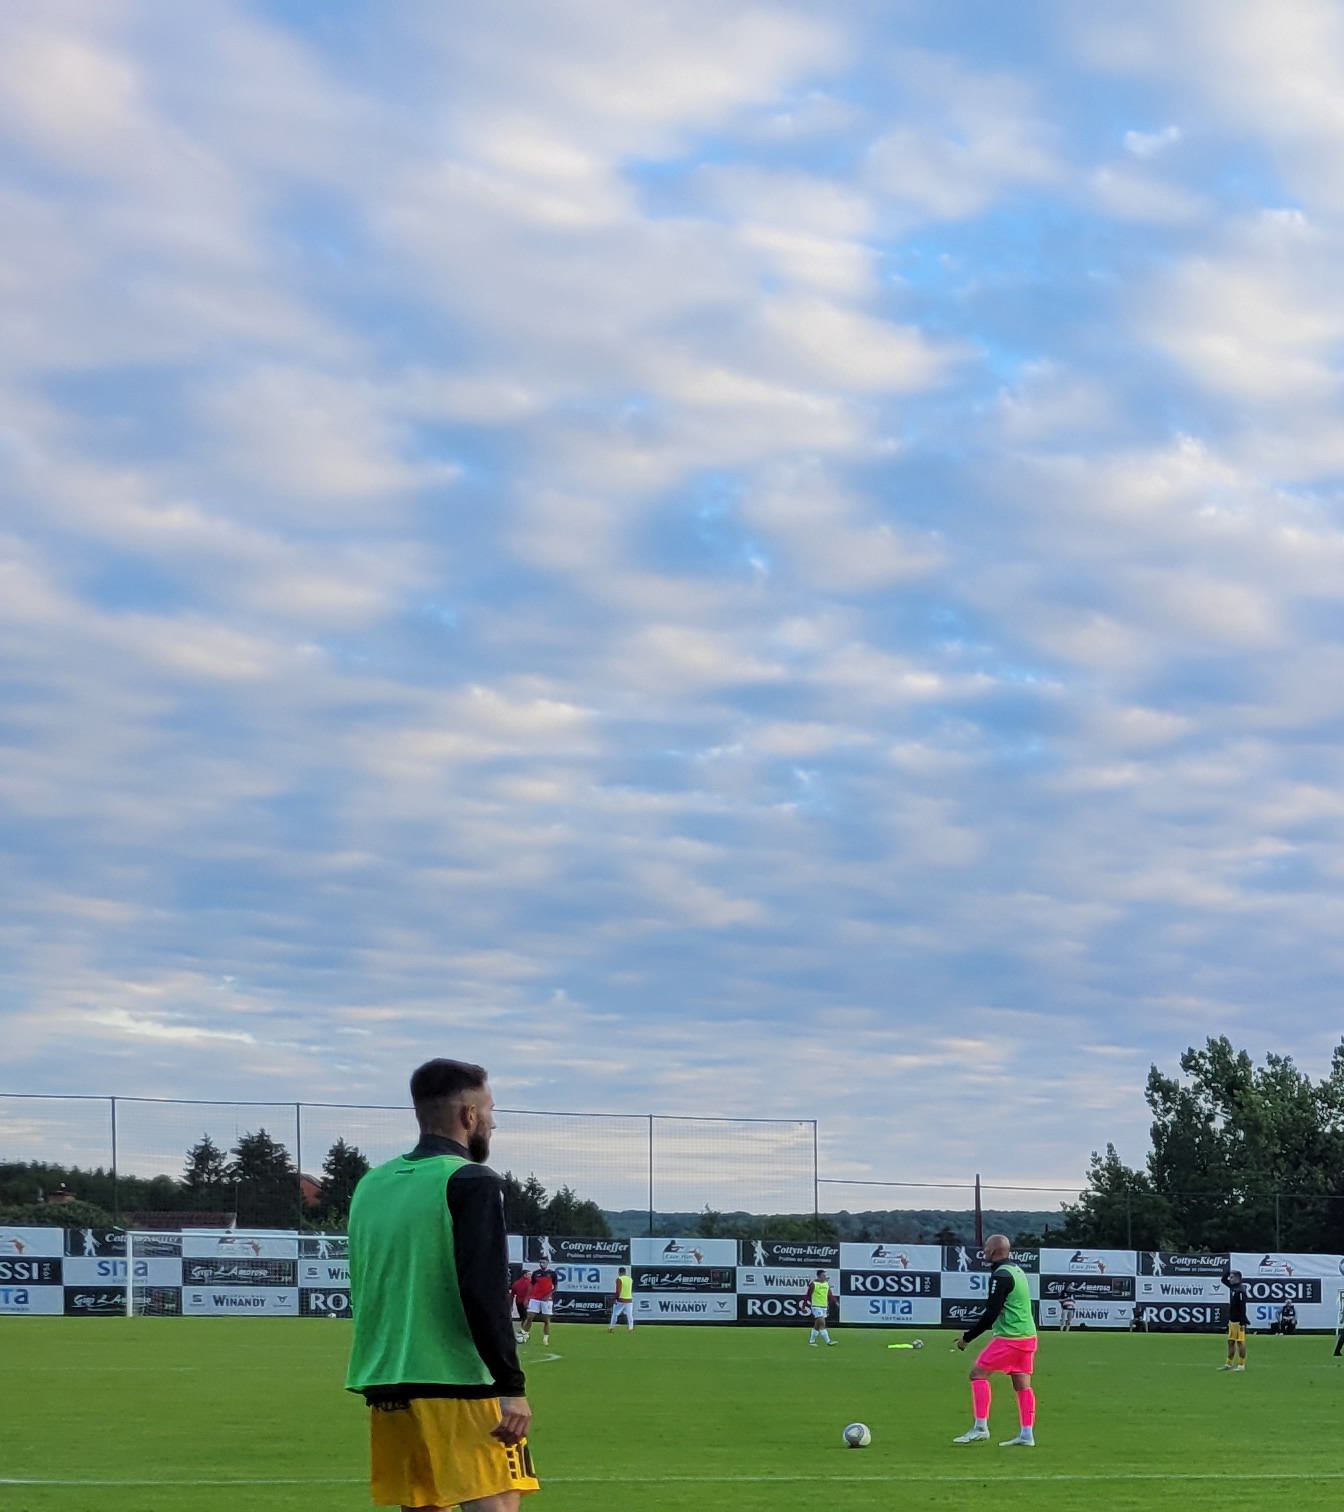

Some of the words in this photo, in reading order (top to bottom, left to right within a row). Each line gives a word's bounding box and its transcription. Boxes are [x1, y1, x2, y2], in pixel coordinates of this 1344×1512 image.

[561, 1241, 628, 1253] Cottyn-Kieffer
[773, 1245, 838, 1257] Cottyn-Kieffer
[1170, 1256, 1229, 1266] Cottyn-Kieffer
[640, 1274, 659, 1286] Gigi
[851, 1275, 920, 1292] ROSSI
[747, 1299, 812, 1317] ROSS
[1073, 1308, 1109, 1320] INANDY
[1146, 1307, 1211, 1323] ROSSI
